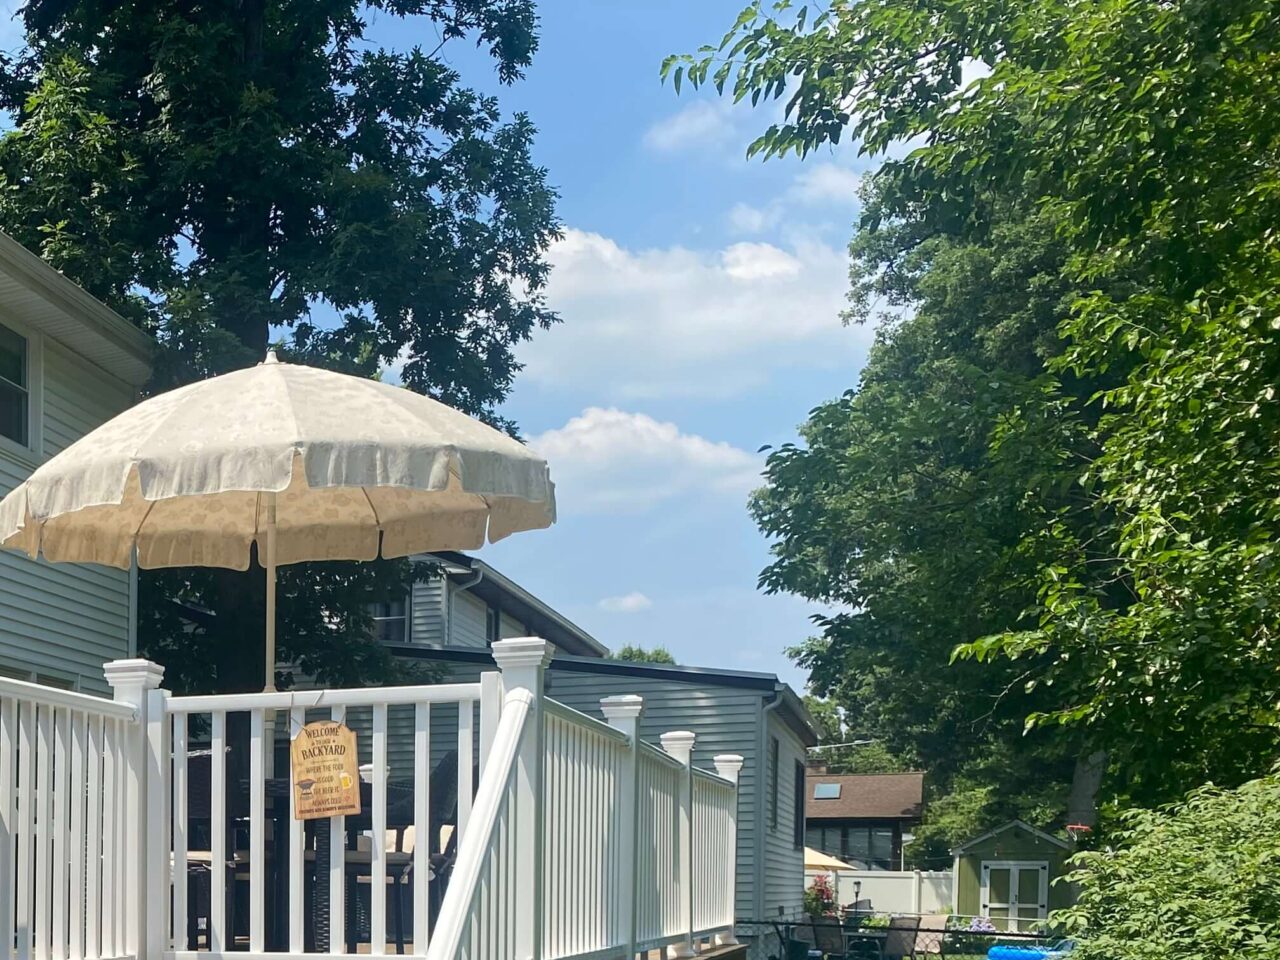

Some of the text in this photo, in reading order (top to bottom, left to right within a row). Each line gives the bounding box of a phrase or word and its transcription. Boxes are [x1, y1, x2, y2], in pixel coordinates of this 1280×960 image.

[305, 727, 339, 739] WELCOME
[301, 744, 346, 760] BACKYARD
[323, 764, 331, 772] THE
